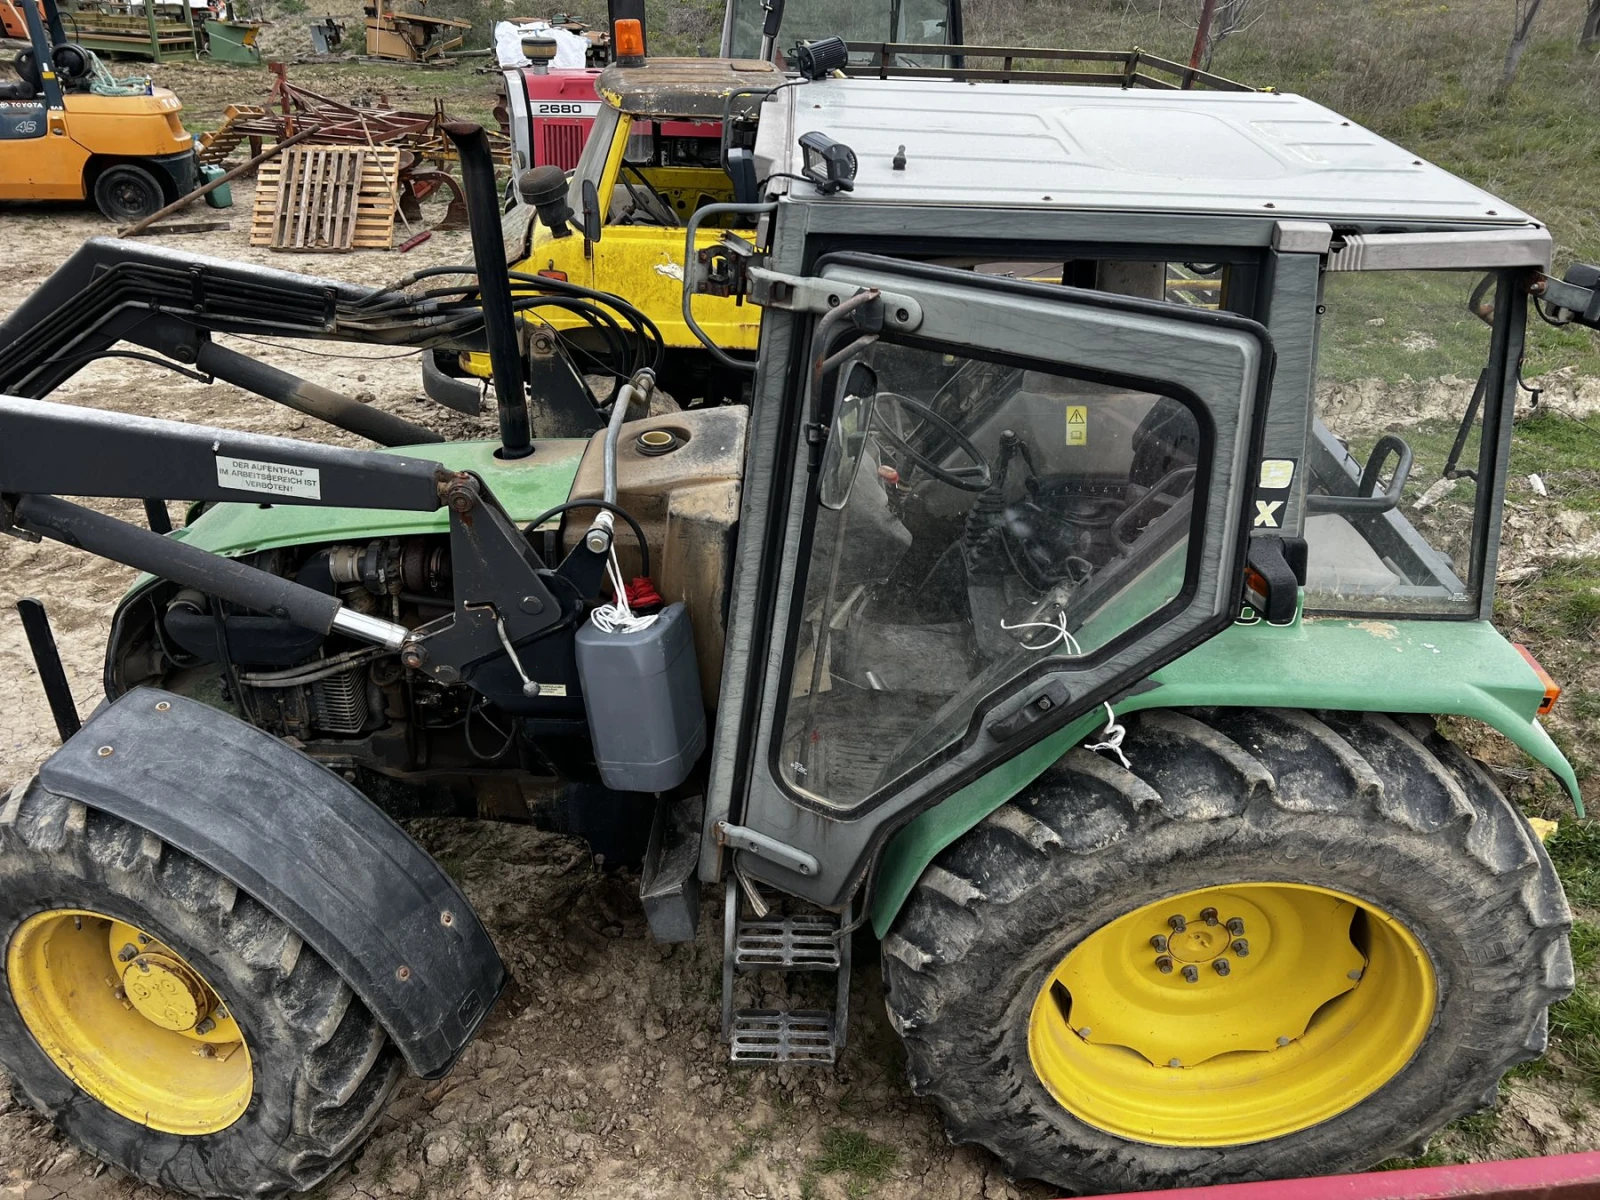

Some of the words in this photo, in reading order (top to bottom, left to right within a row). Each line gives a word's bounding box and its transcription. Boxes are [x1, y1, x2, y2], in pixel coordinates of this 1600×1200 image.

[539, 104, 582, 114] 2680
[15, 120, 37, 133] 45
[232, 461, 249, 469] DER
[251, 464, 304, 476] AUFENTHALT
[231, 469, 302, 485] ARBEITSBEREICH
[245, 480, 293, 492] VERBOTEN!
[1253, 500, 1285, 528] X
